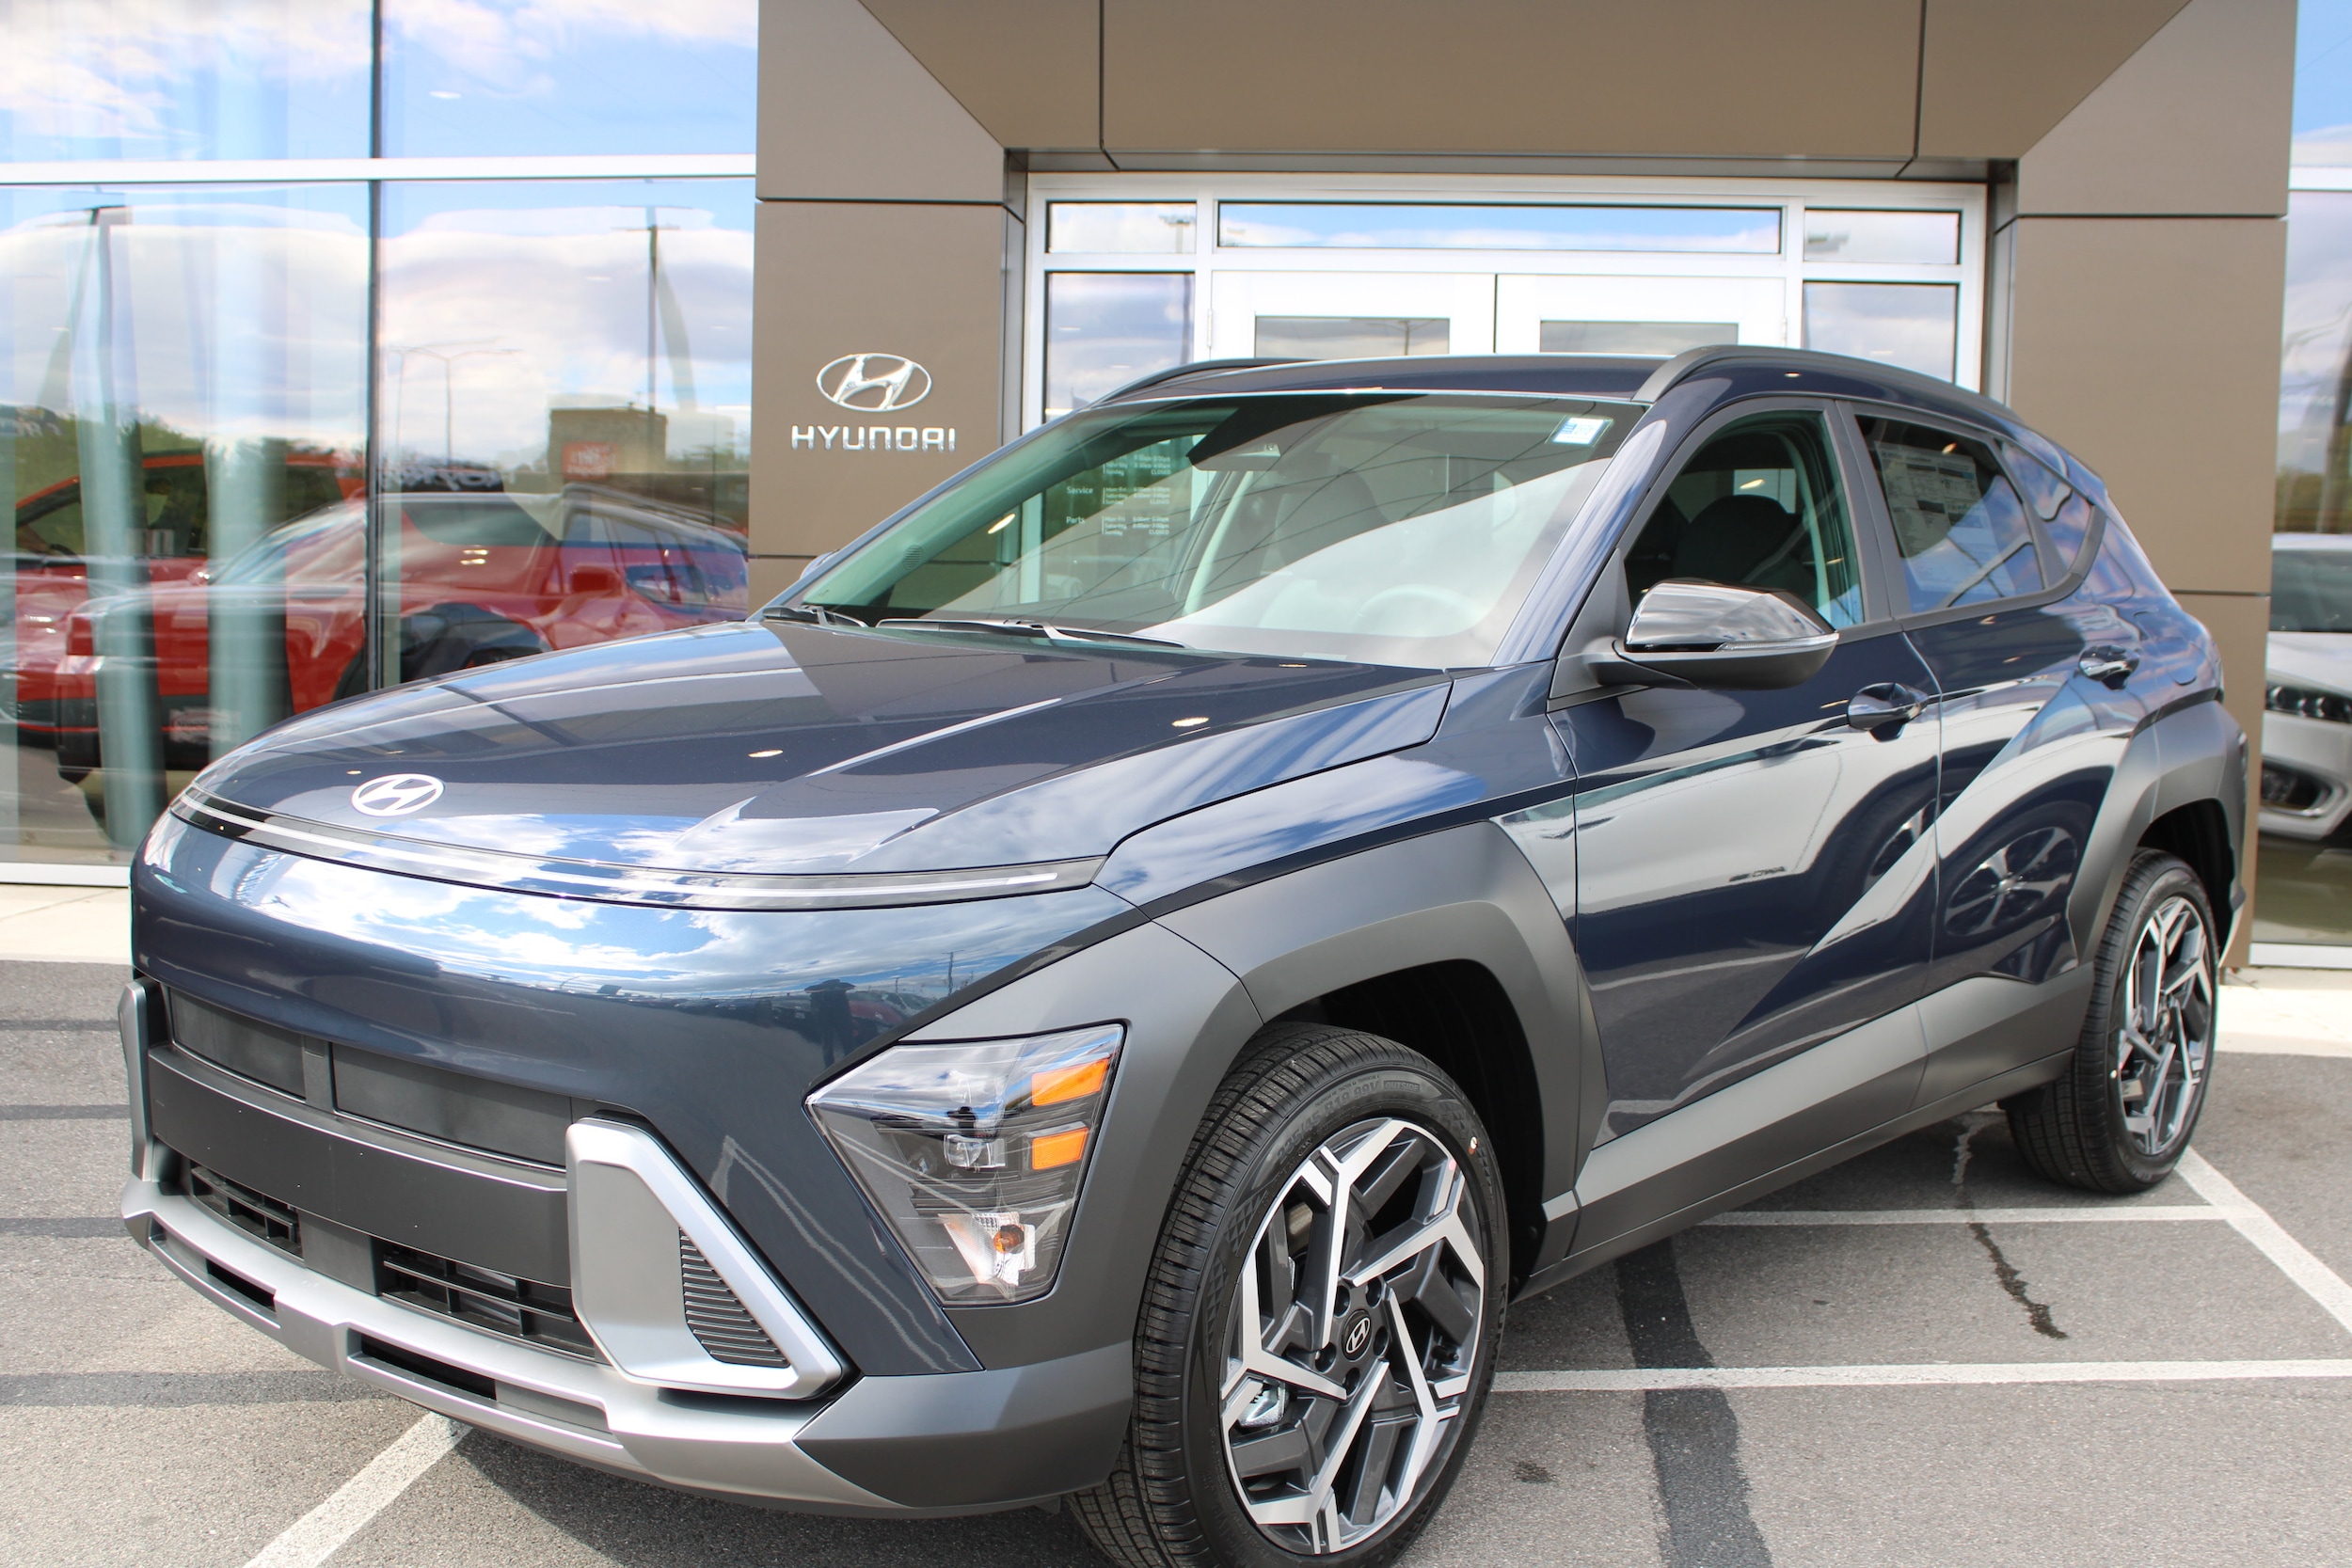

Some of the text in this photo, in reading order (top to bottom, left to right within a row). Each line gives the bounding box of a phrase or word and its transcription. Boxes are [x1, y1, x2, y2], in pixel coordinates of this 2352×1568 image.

[791, 424, 956, 452] HYUNDAI
[1066, 515, 1085, 524] Parts
[1385, 1081, 1420, 1092] OUTSIDE
